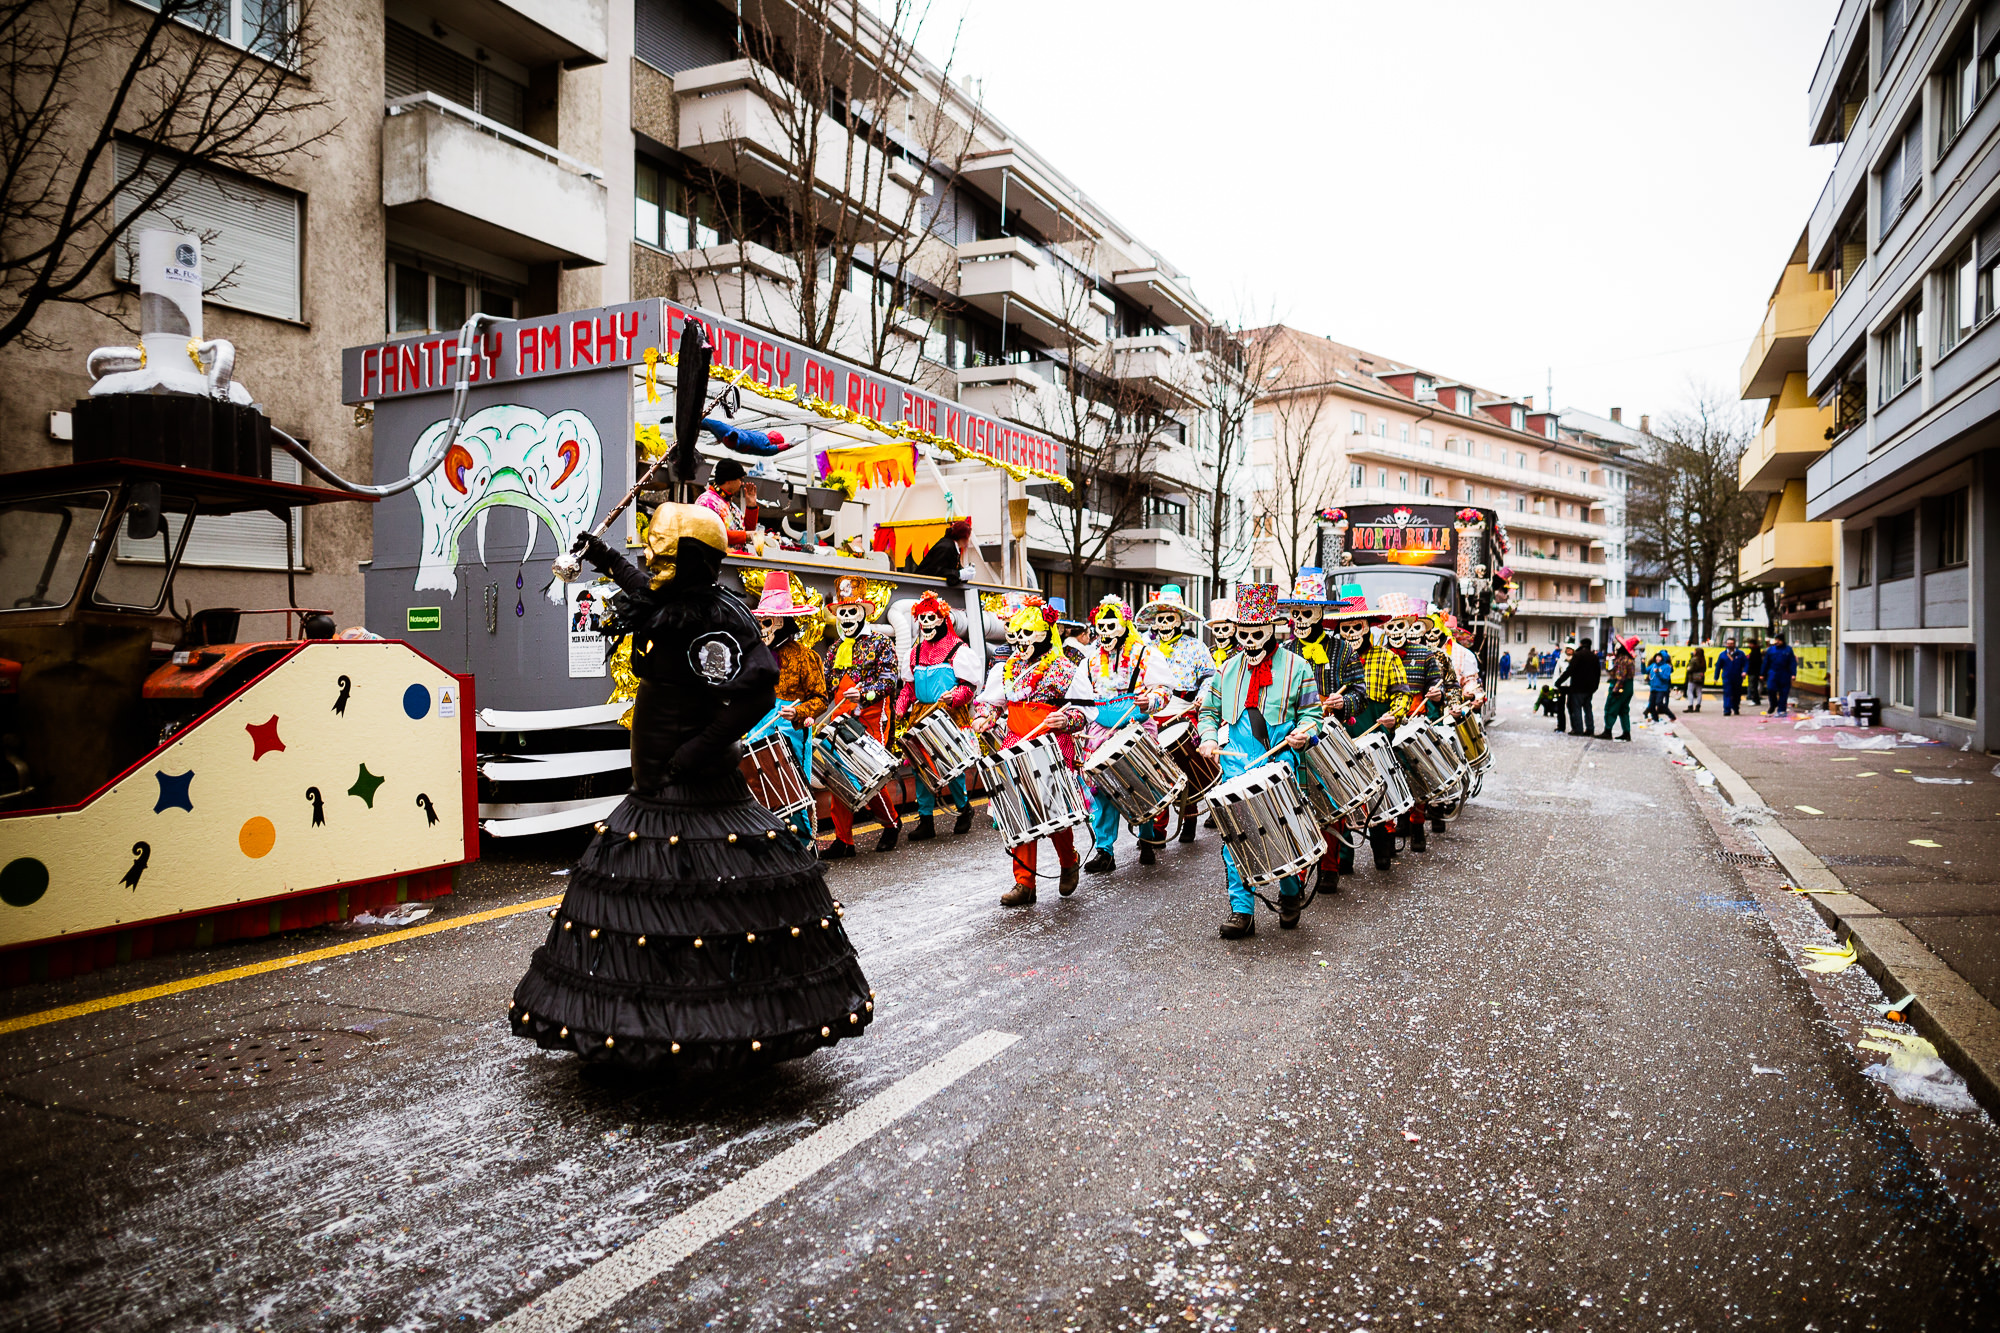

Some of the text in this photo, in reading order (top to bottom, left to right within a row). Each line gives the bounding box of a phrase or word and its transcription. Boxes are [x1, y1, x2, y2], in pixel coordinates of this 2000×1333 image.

[515, 325, 561, 376] AM
[569, 311, 639, 368] RHY
[665, 305, 791, 388] FNTASY
[803, 358, 835, 404] AM
[846, 372, 886, 422] RHY
[902, 391, 937, 435] 2016
[1351, 527, 1451, 551] MORTA BELLA
[409, 615, 439, 624] Notausgang
